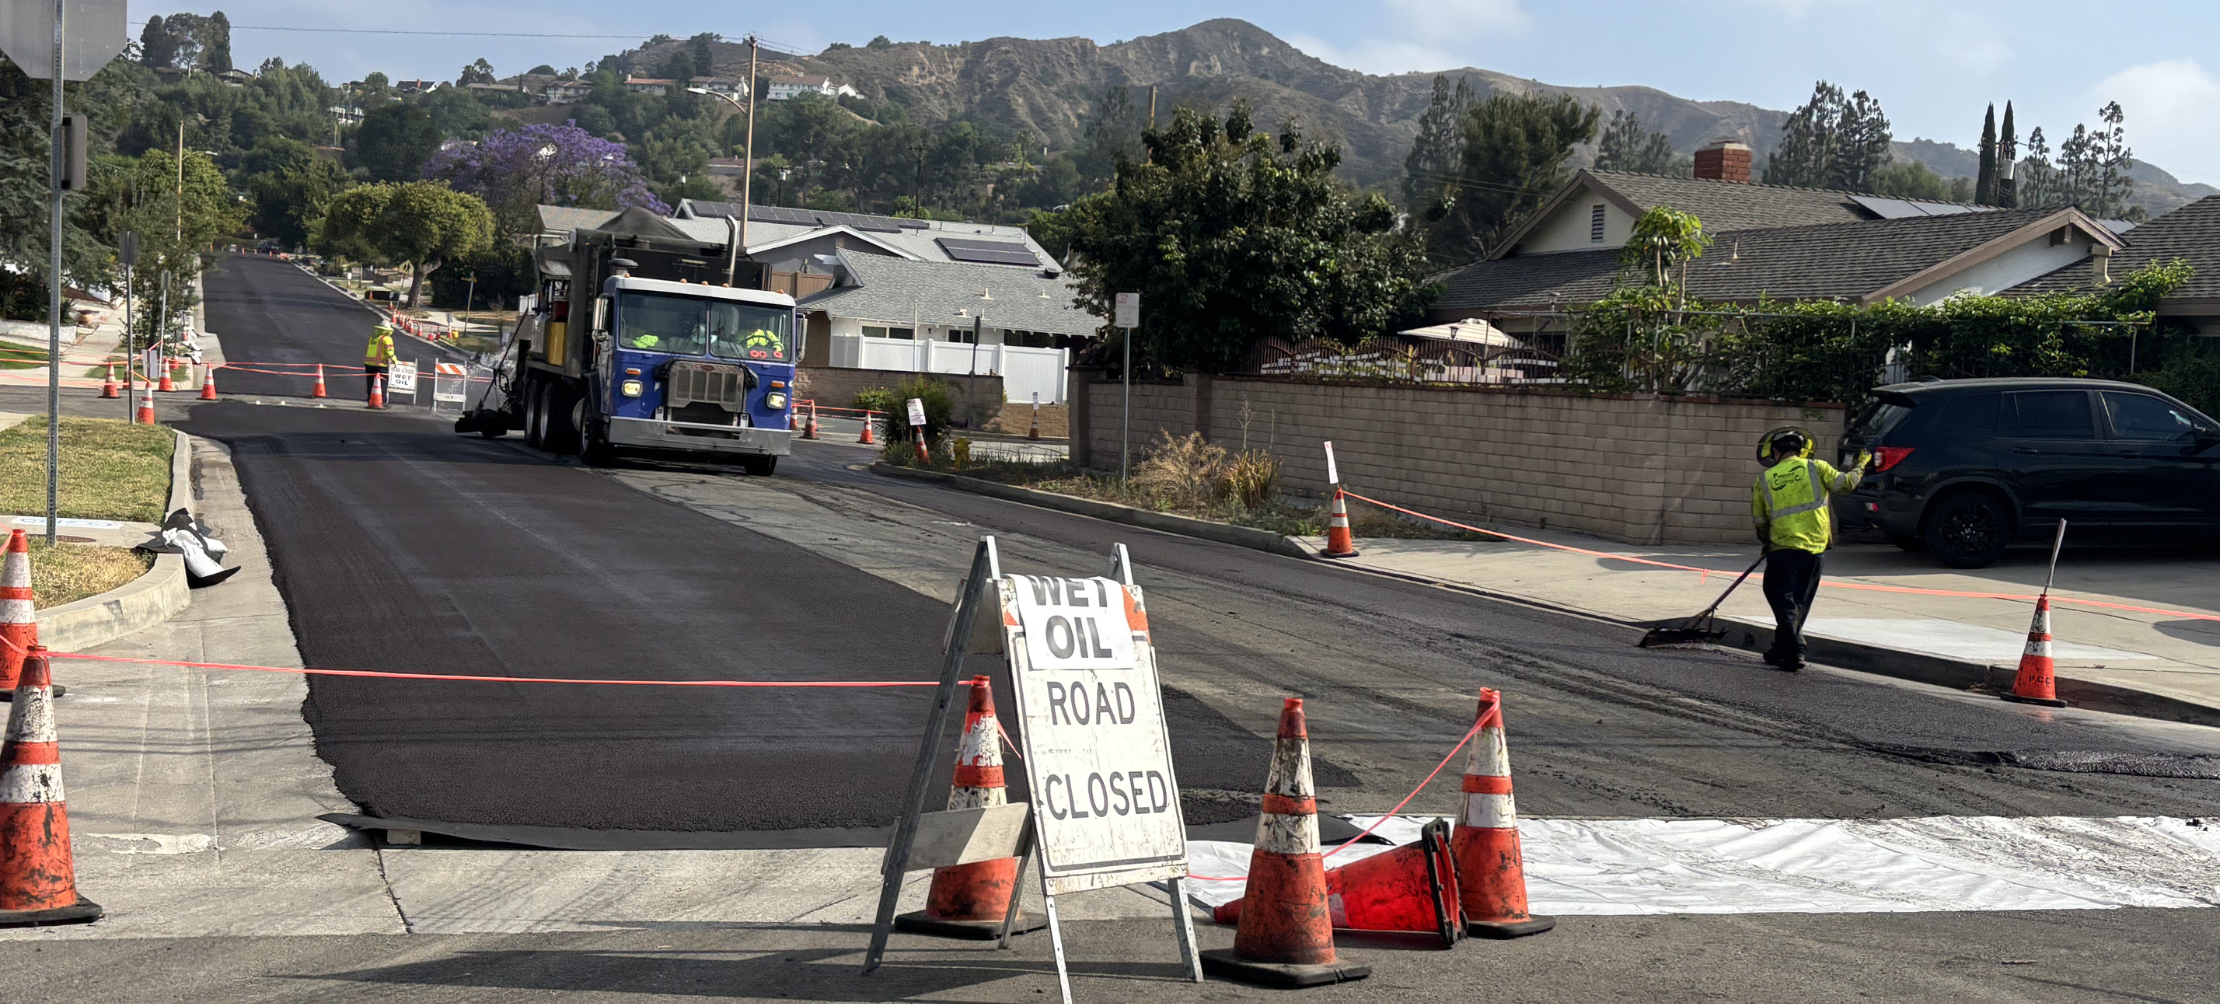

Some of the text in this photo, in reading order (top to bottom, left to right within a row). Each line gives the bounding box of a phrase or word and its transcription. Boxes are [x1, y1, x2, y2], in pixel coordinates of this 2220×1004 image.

[1045, 615, 1113, 660] OIL
[1046, 680, 1136, 726] ROAD
[1045, 770, 1168, 821] CLOSED
